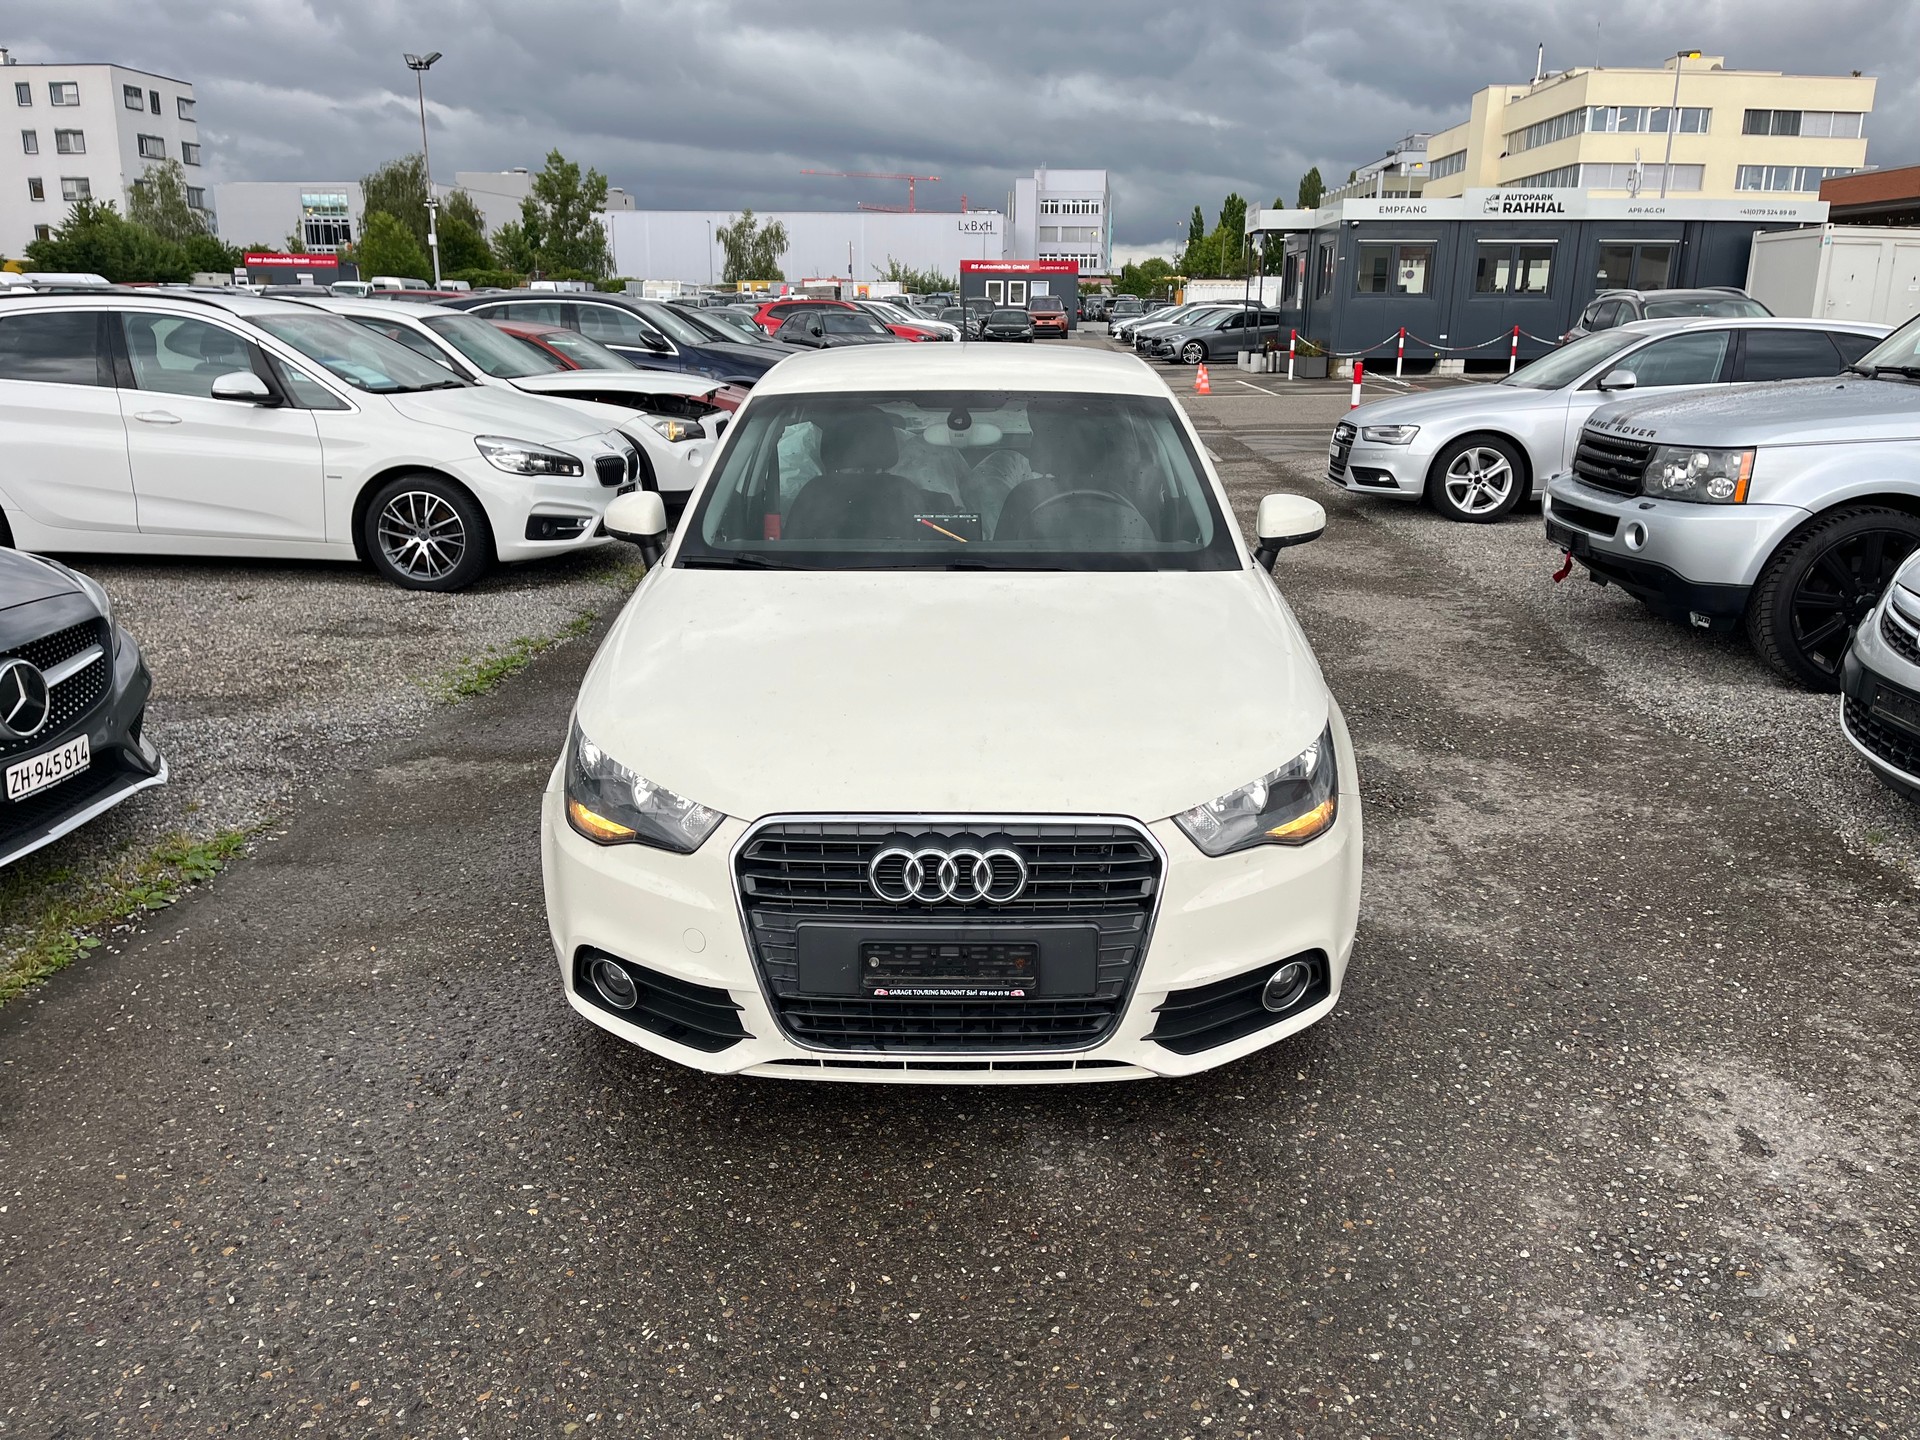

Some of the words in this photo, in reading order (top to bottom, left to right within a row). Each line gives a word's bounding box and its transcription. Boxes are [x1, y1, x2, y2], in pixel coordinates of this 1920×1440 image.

[1504, 193, 1554, 202] AUTOPARK
[1378, 205, 1428, 214] EMPFANG
[1502, 202, 1565, 214] RAHHAL
[1588, 418, 1612, 430] RANGE
[1614, 425, 1657, 438] ROVER
